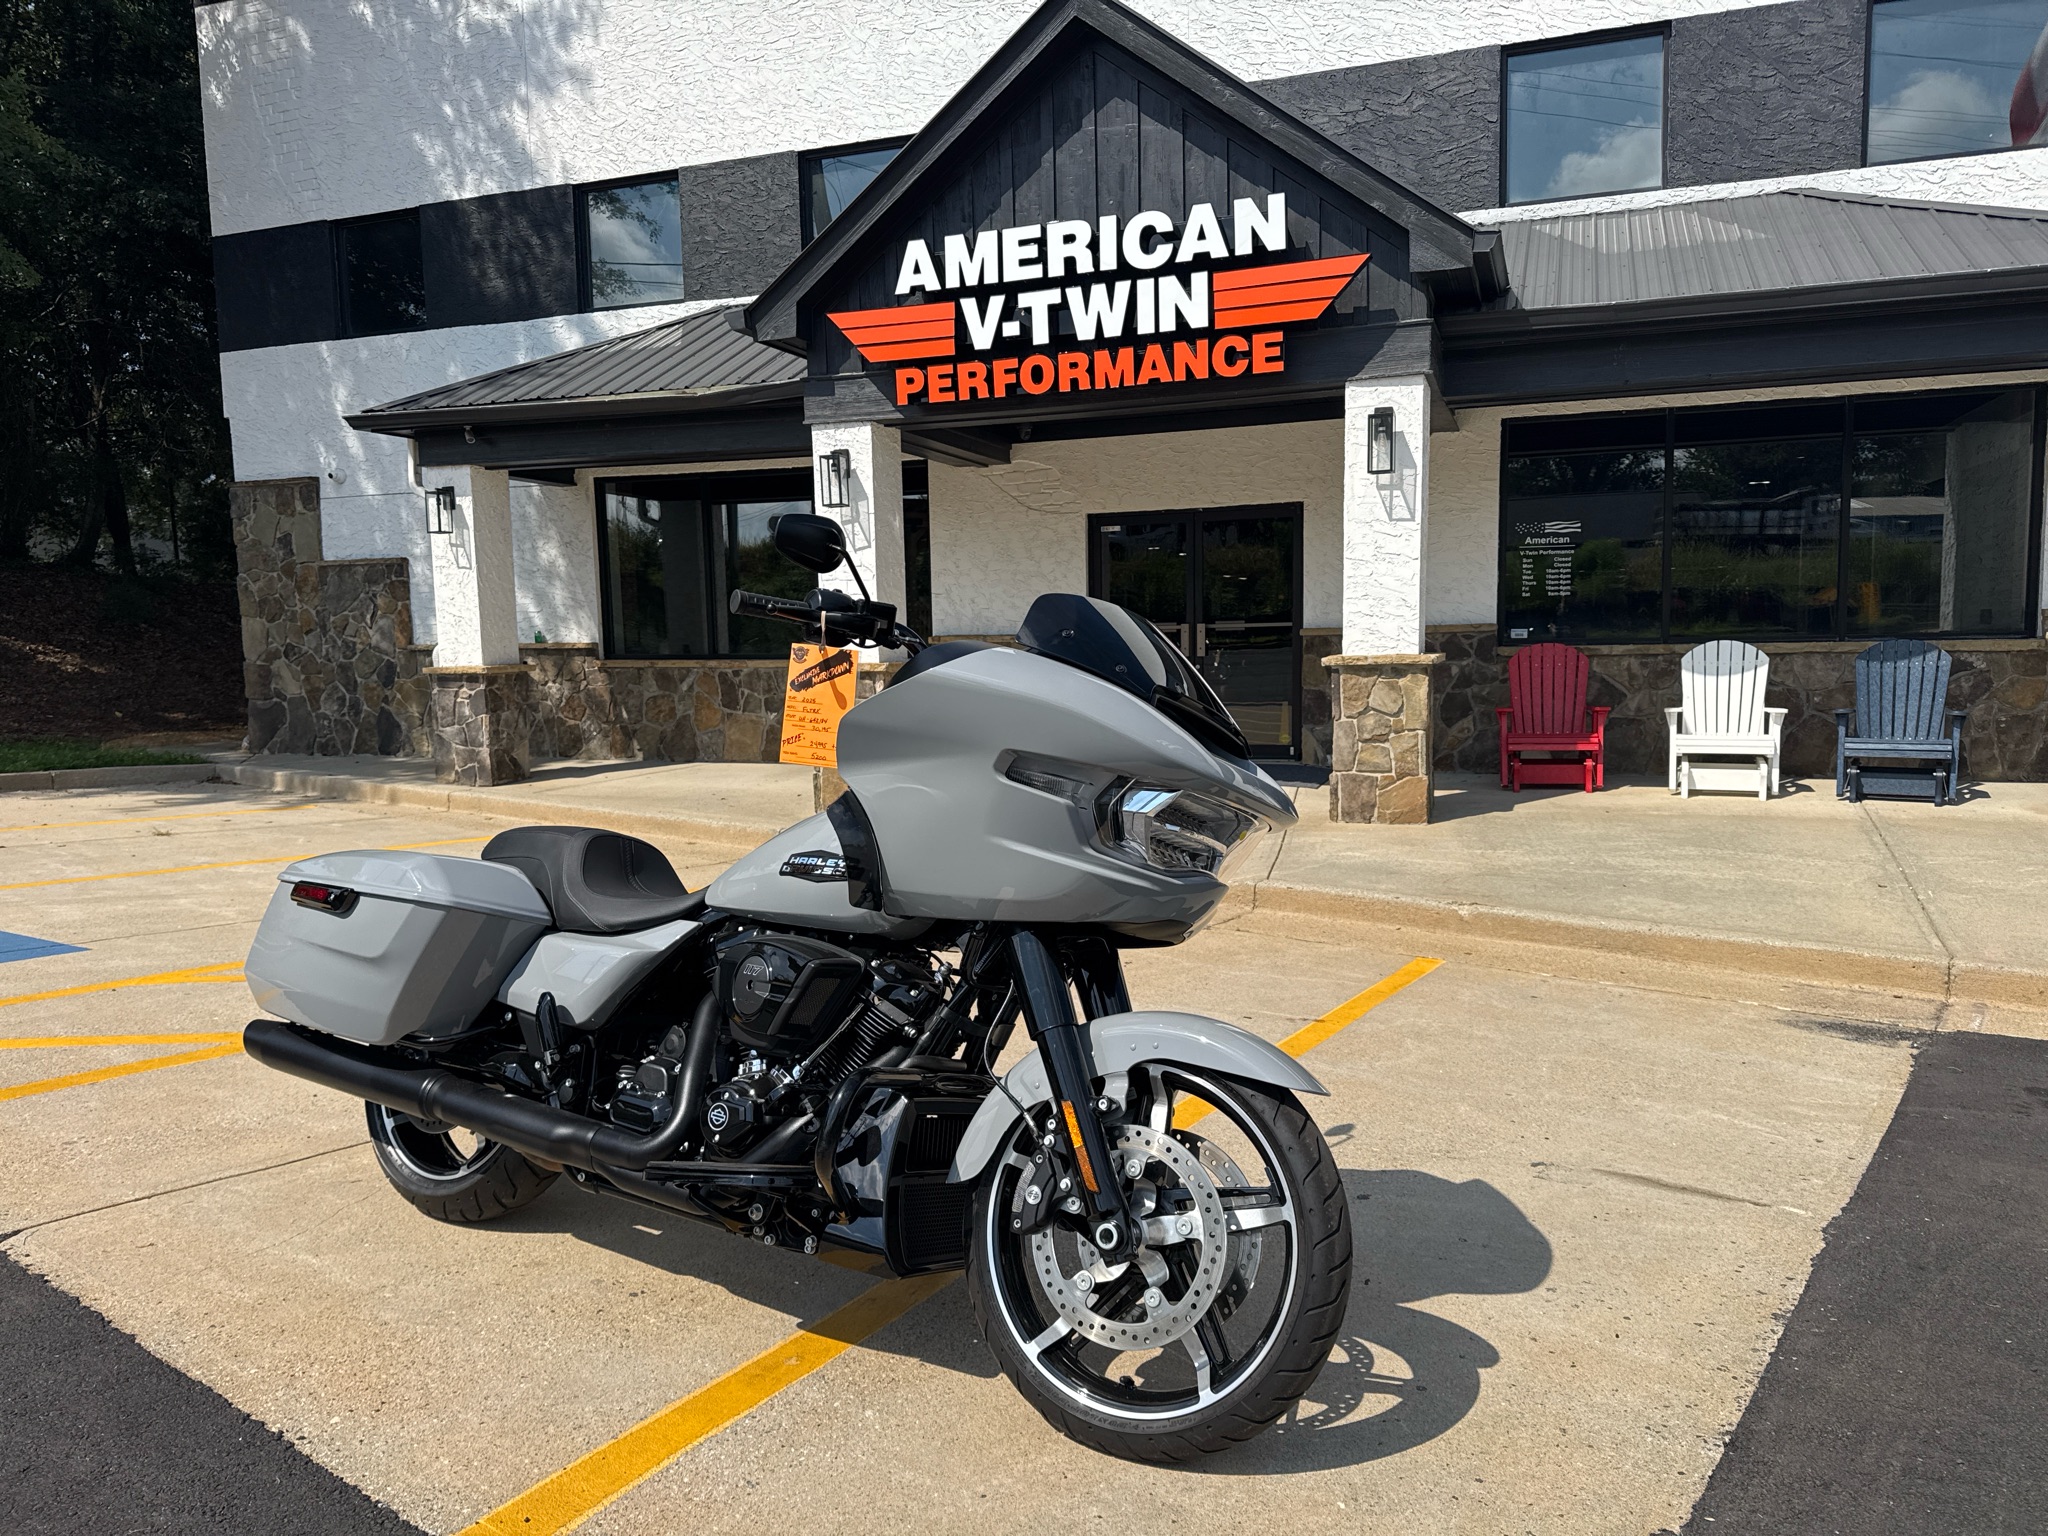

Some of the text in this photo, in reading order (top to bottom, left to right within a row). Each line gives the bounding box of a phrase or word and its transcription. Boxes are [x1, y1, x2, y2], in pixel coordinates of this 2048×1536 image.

[895, 193, 1287, 295] AMERICAN
[960, 271, 1209, 350] V-TWIN
[895, 331, 1284, 406] PERFORMANCE
[1525, 536, 1570, 544] American
[811, 661, 850, 685] MARKDOWN
[781, 864, 847, 875] DAVIDSO
[789, 856, 846, 866] HARLEY
[743, 963, 765, 976] 117
